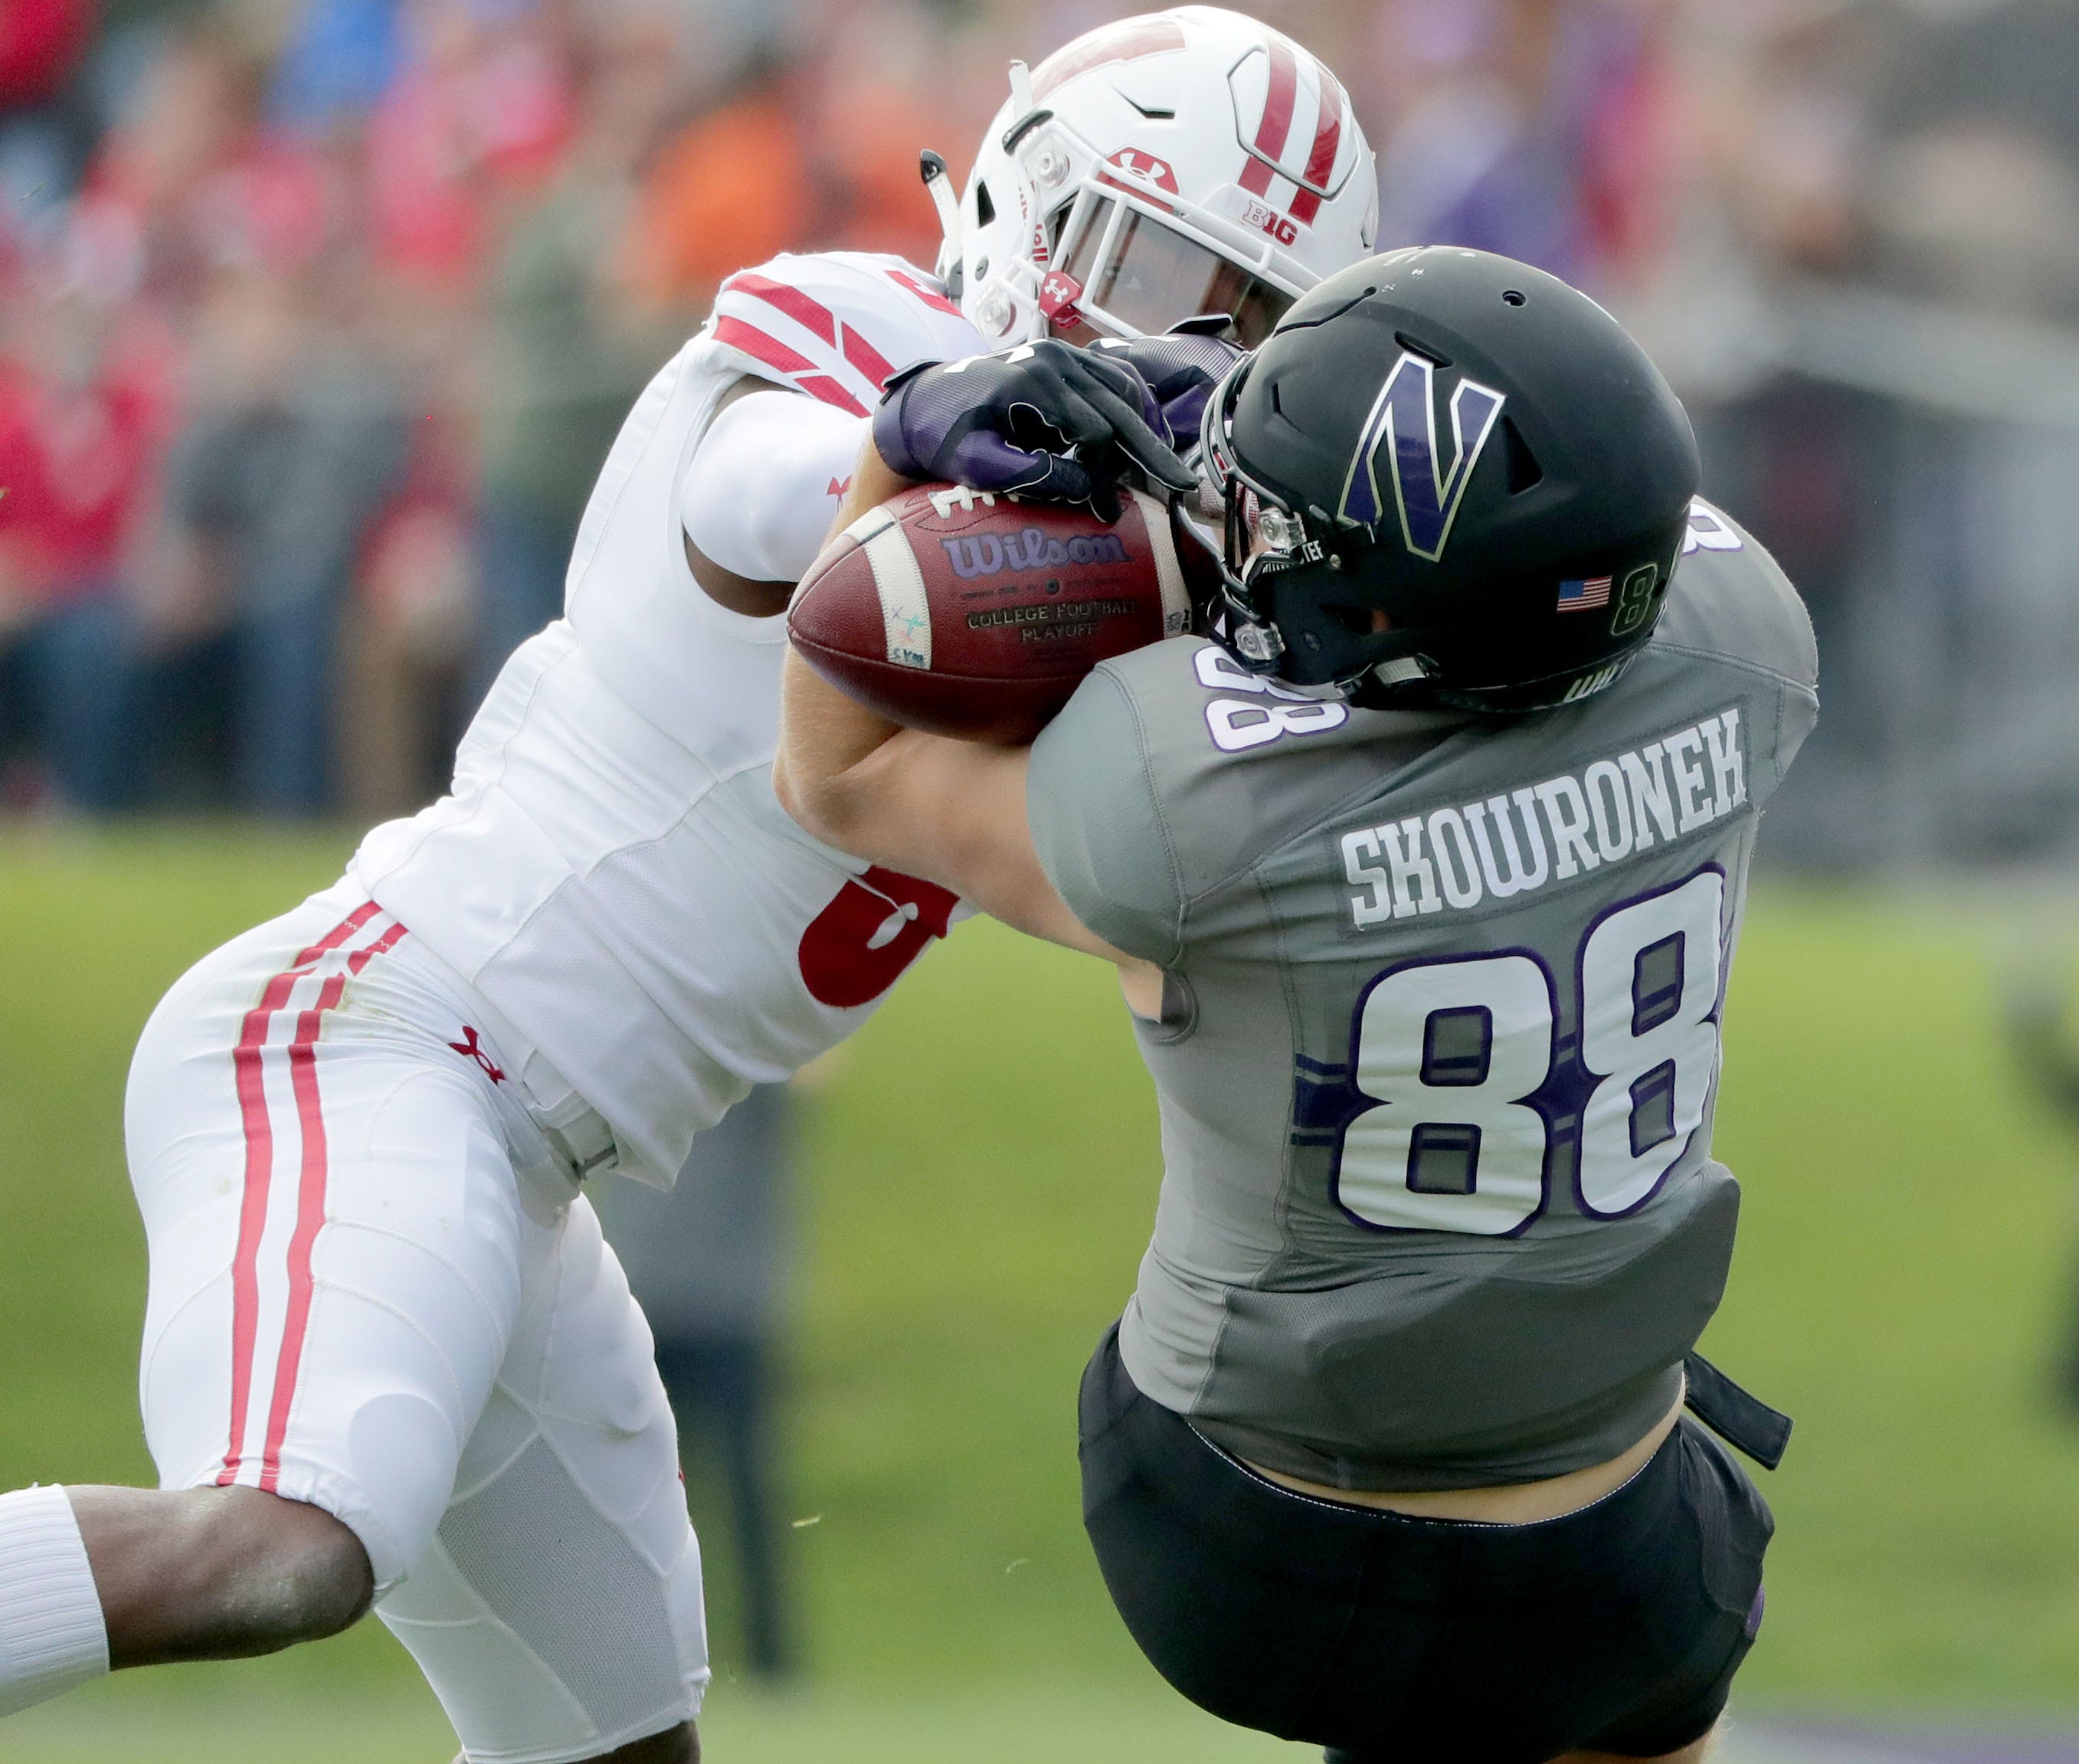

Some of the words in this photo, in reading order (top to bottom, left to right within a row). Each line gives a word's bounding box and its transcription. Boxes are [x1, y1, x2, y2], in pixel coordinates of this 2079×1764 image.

[941, 526, 1134, 581] Wilson
[967, 605, 1049, 630] COLLEGE
[1056, 601, 1140, 619] FOOTBALL
[1021, 623, 1097, 643] PLAYOFF
[1341, 708, 1749, 928] SKOWRONEK
[1329, 861, 1727, 1239] 88
